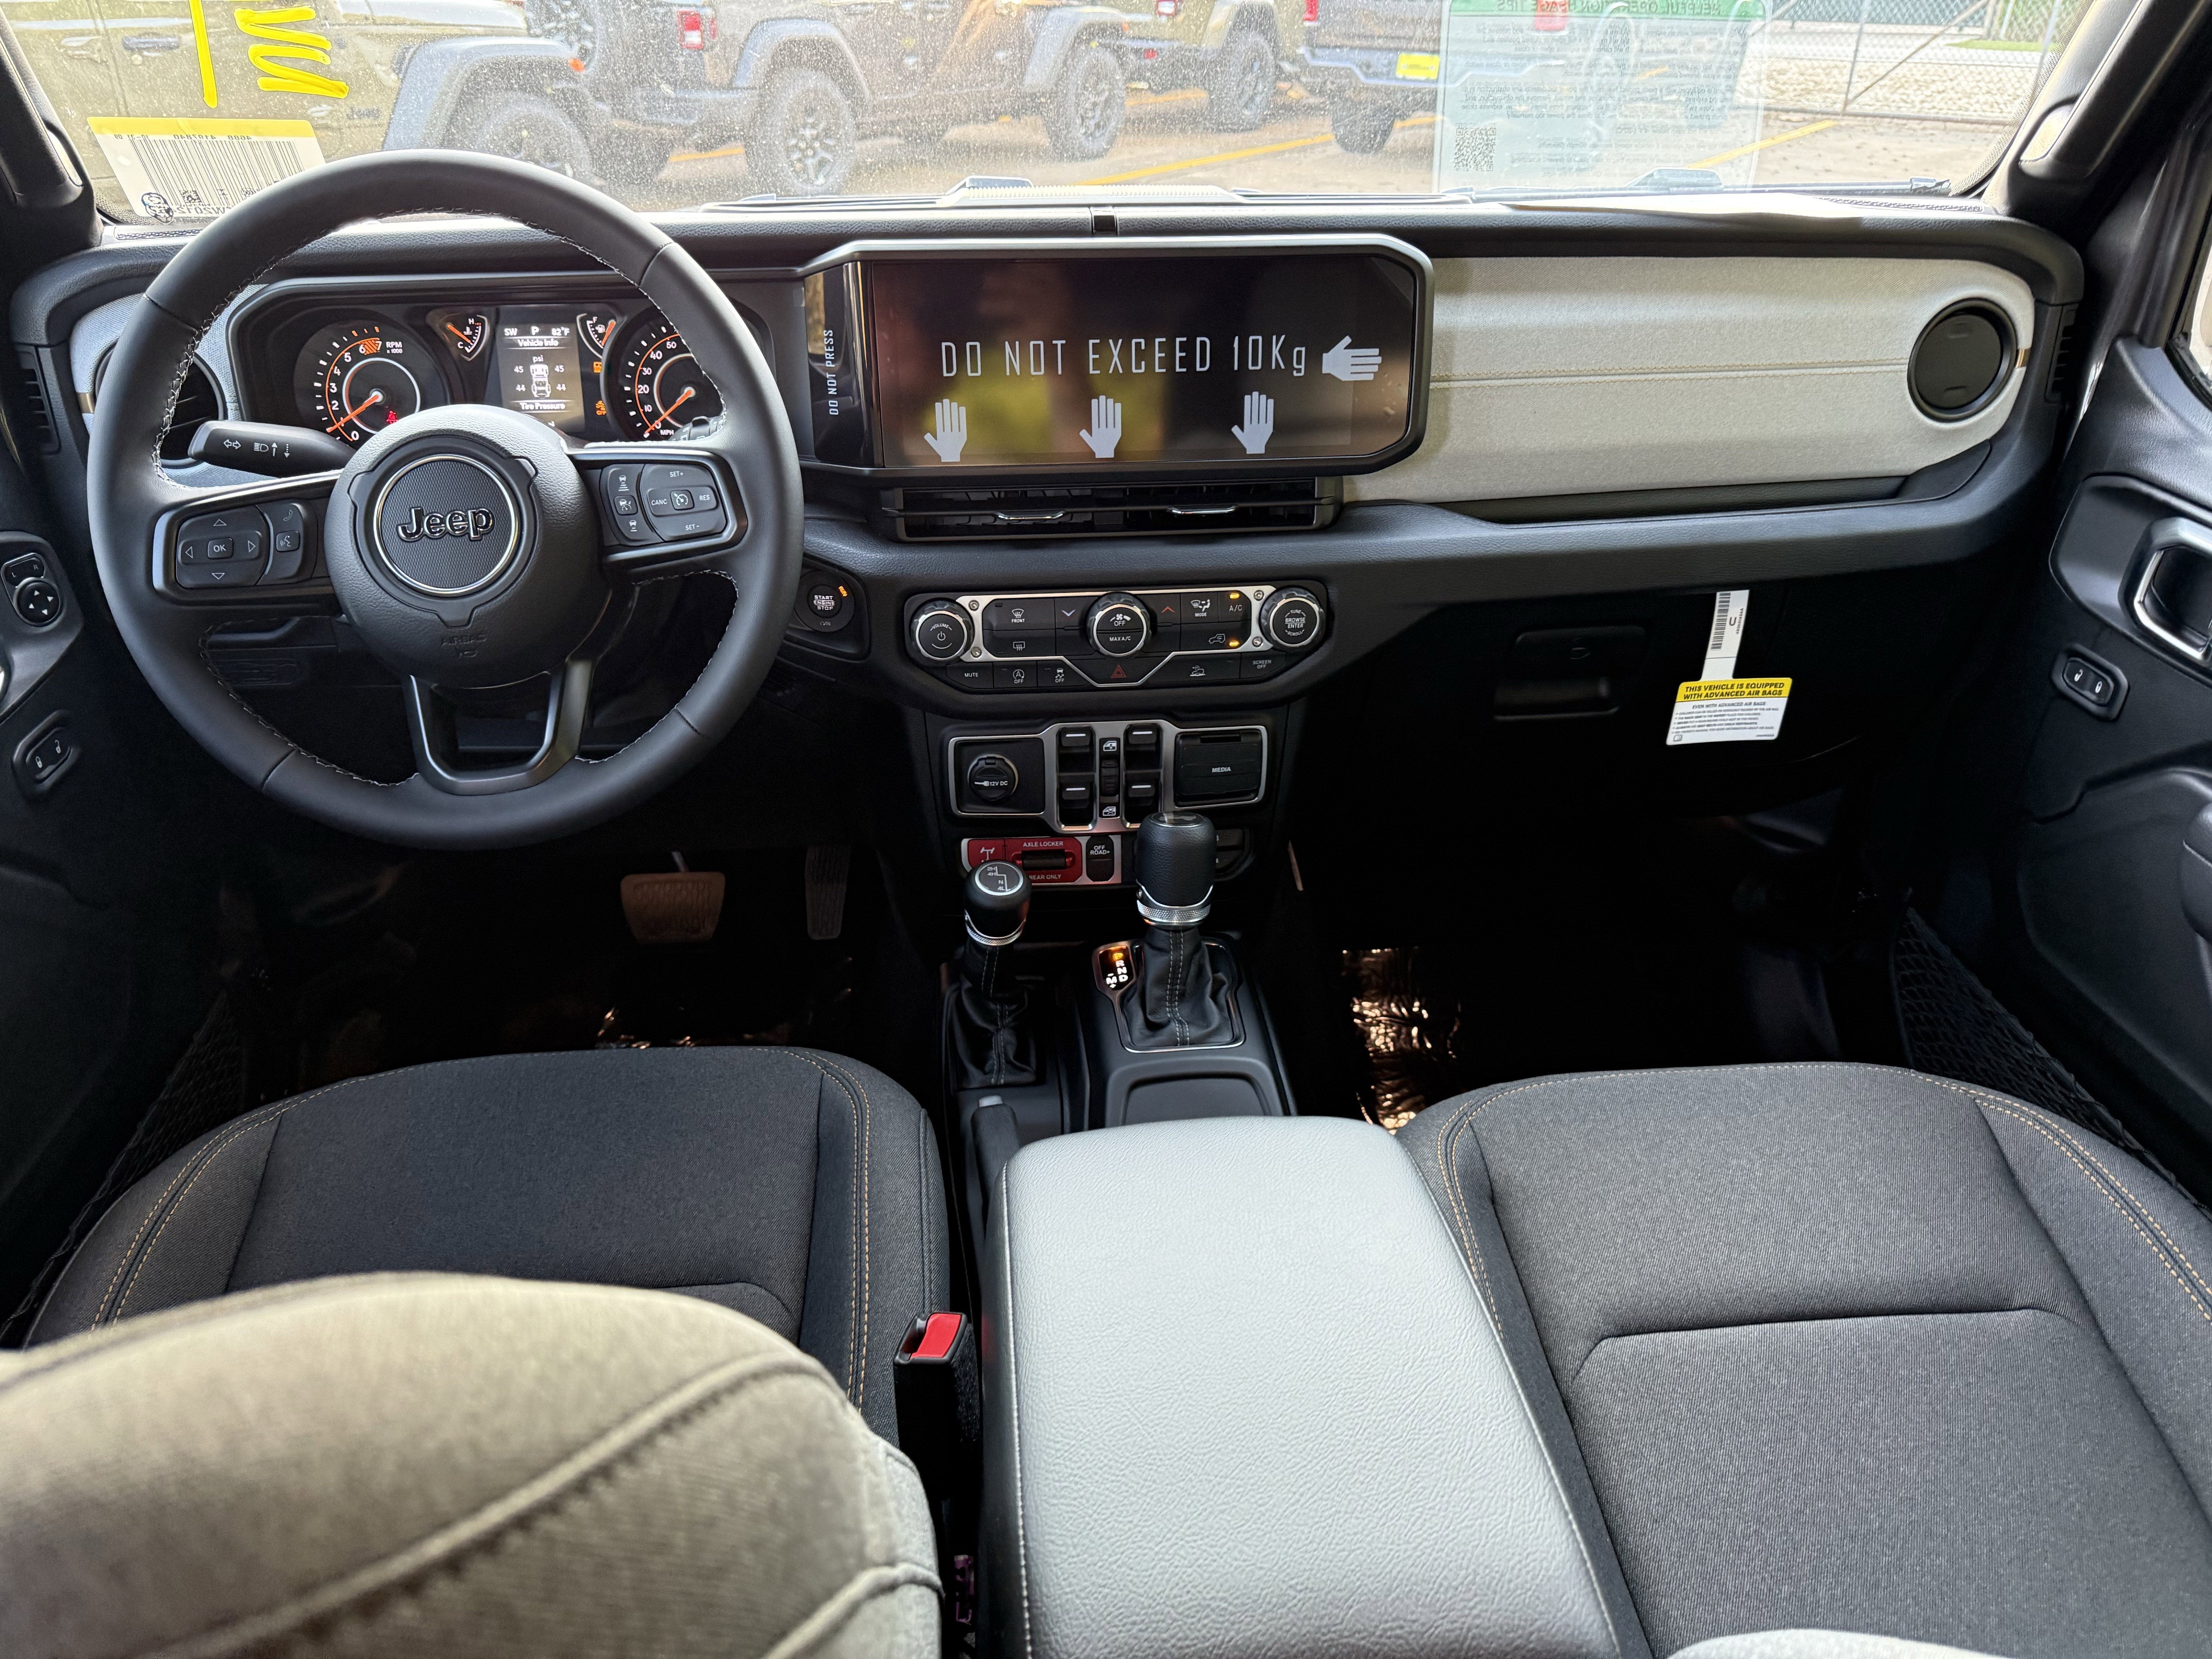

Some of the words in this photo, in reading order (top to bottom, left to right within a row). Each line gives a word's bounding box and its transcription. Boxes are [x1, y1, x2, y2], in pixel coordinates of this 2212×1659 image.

[531, 326, 540, 335] P
[375, 340, 382, 351] 7
[544, 338, 559, 347] Info
[359, 344, 366, 354] 6
[823, 330, 835, 367] PRESS
[344, 352, 352, 362] 5
[532, 355, 543, 363] psi
[650, 351, 663, 360] 40
[941, 341, 981, 377] DO
[1005, 340, 1066, 376] NOT
[1088, 337, 1211, 374] EXCEED
[1233, 335, 1306, 377] 10Kg
[334, 366, 341, 376] 4
[642, 368, 652, 376] 30
[330, 383, 337, 393] 3
[515, 384, 526, 392] 44
[826, 373, 837, 395] NOT
[637, 385, 650, 394] 20
[331, 400, 339, 410] 2
[828, 400, 839, 415] DO
[654, 420, 661, 429] 0
[351, 431, 359, 441] 0
[398, 507, 495, 541] Jeep
[1113, 952, 1124, 961] P
[1106, 976, 1118, 985] M
